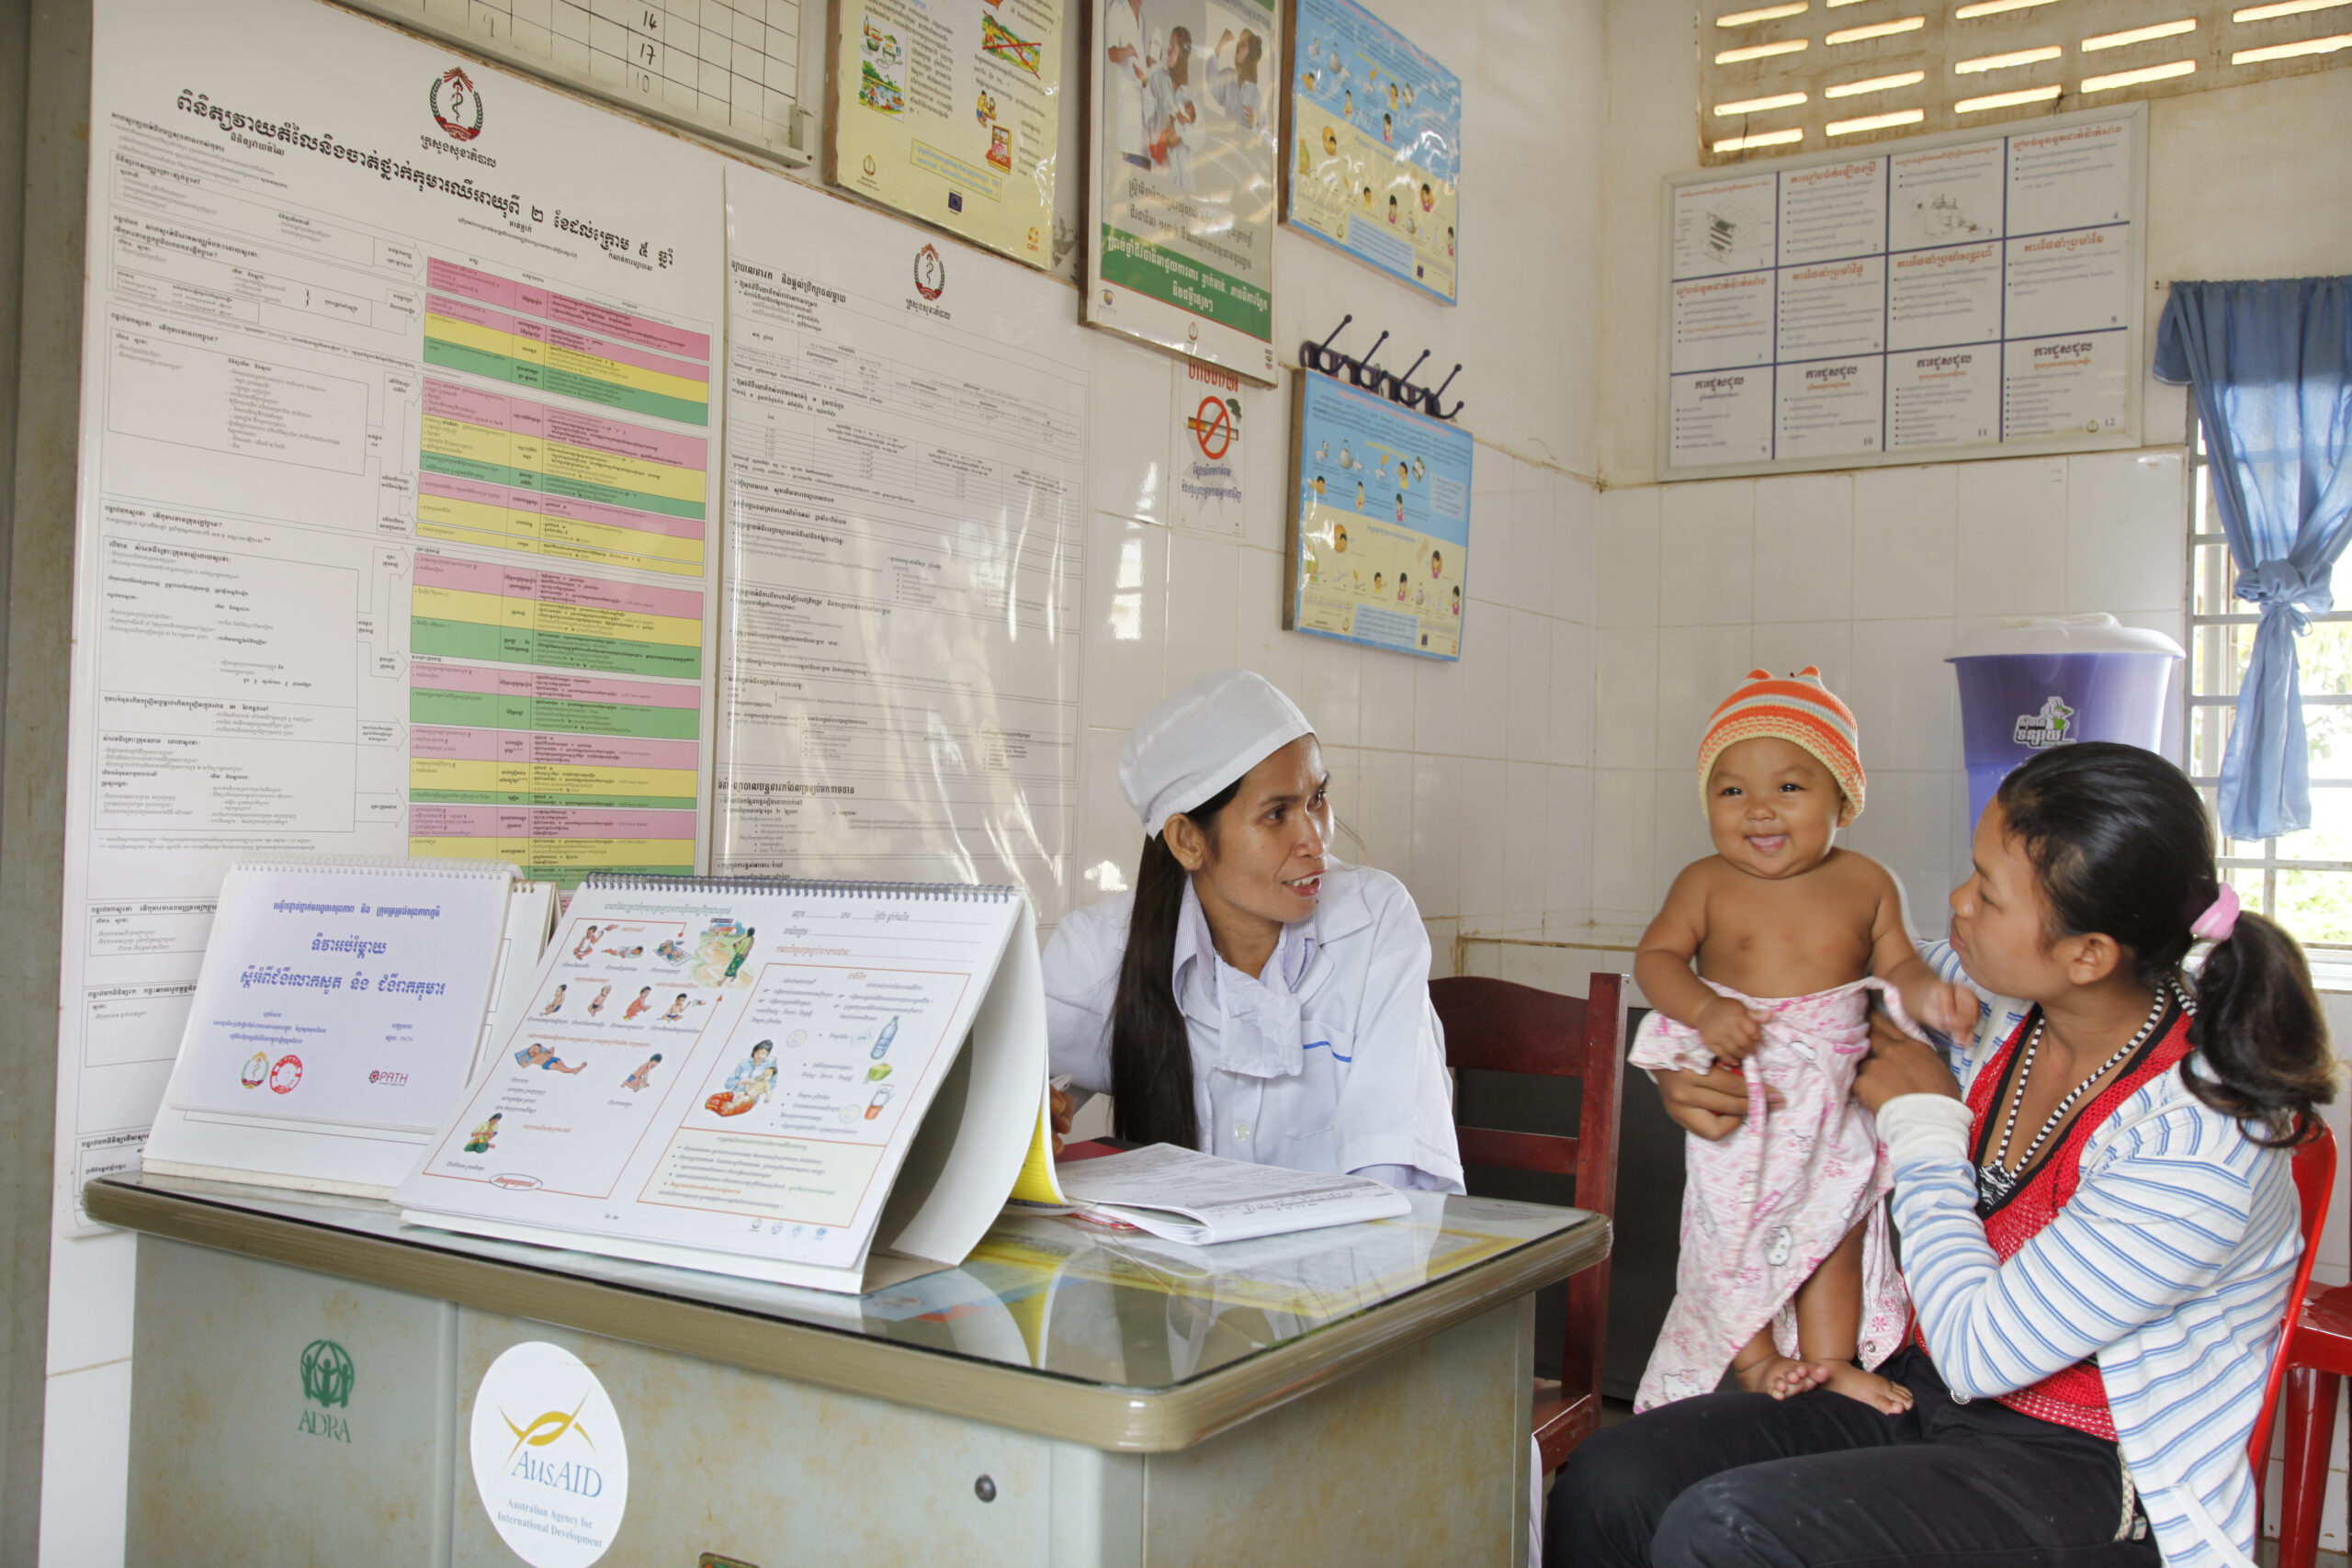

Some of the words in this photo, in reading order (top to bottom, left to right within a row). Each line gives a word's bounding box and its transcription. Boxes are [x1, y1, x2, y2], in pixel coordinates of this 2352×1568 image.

[643, 9, 658, 30] 14
[639, 42, 657, 65] 17
[421, 135, 497, 168] ក្រសួងសុខាភិបាល
[350, 971, 369, 991] និង
[379, 1071, 409, 1084] PATH
[298, 1409, 352, 1444] ADRA
[511, 1450, 603, 1499] AusAID
[506, 1498, 549, 1517] Australian
[550, 1509, 578, 1529] Agency
[581, 1517, 594, 1529] for
[497, 1511, 549, 1534] International
[550, 1525, 603, 1549] Development
